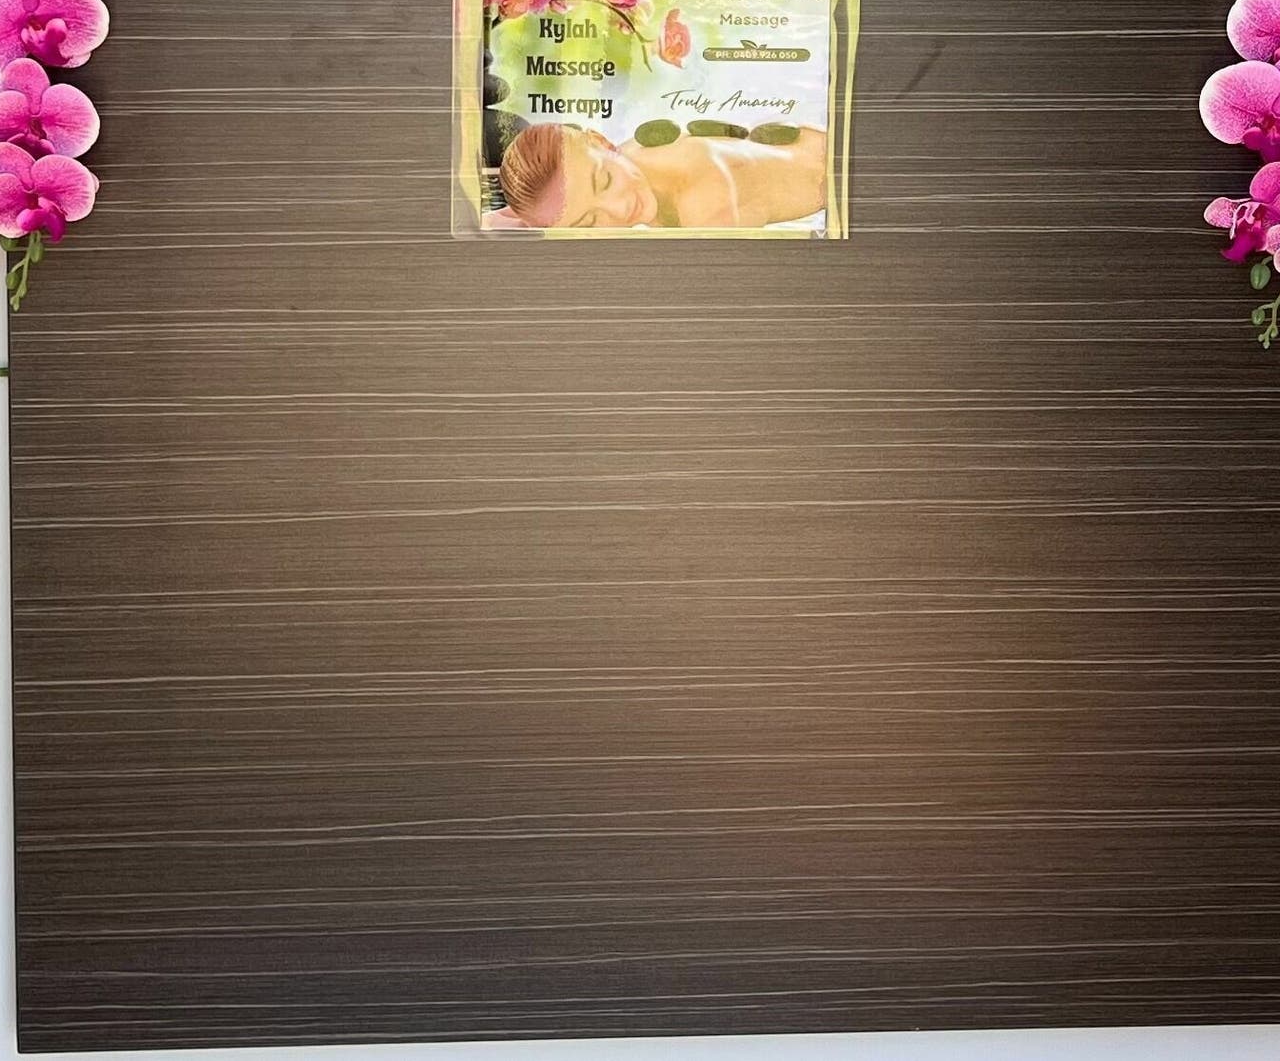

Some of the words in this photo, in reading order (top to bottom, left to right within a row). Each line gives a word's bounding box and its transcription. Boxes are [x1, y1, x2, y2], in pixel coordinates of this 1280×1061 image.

[539, 18, 598, 43] Kylah
[719, 14, 790, 29] Massage
[526, 56, 616, 81] Massage
[527, 93, 614, 119] Therapy
[660, 89, 714, 114] Truly
[718, 89, 799, 115] Amazing
